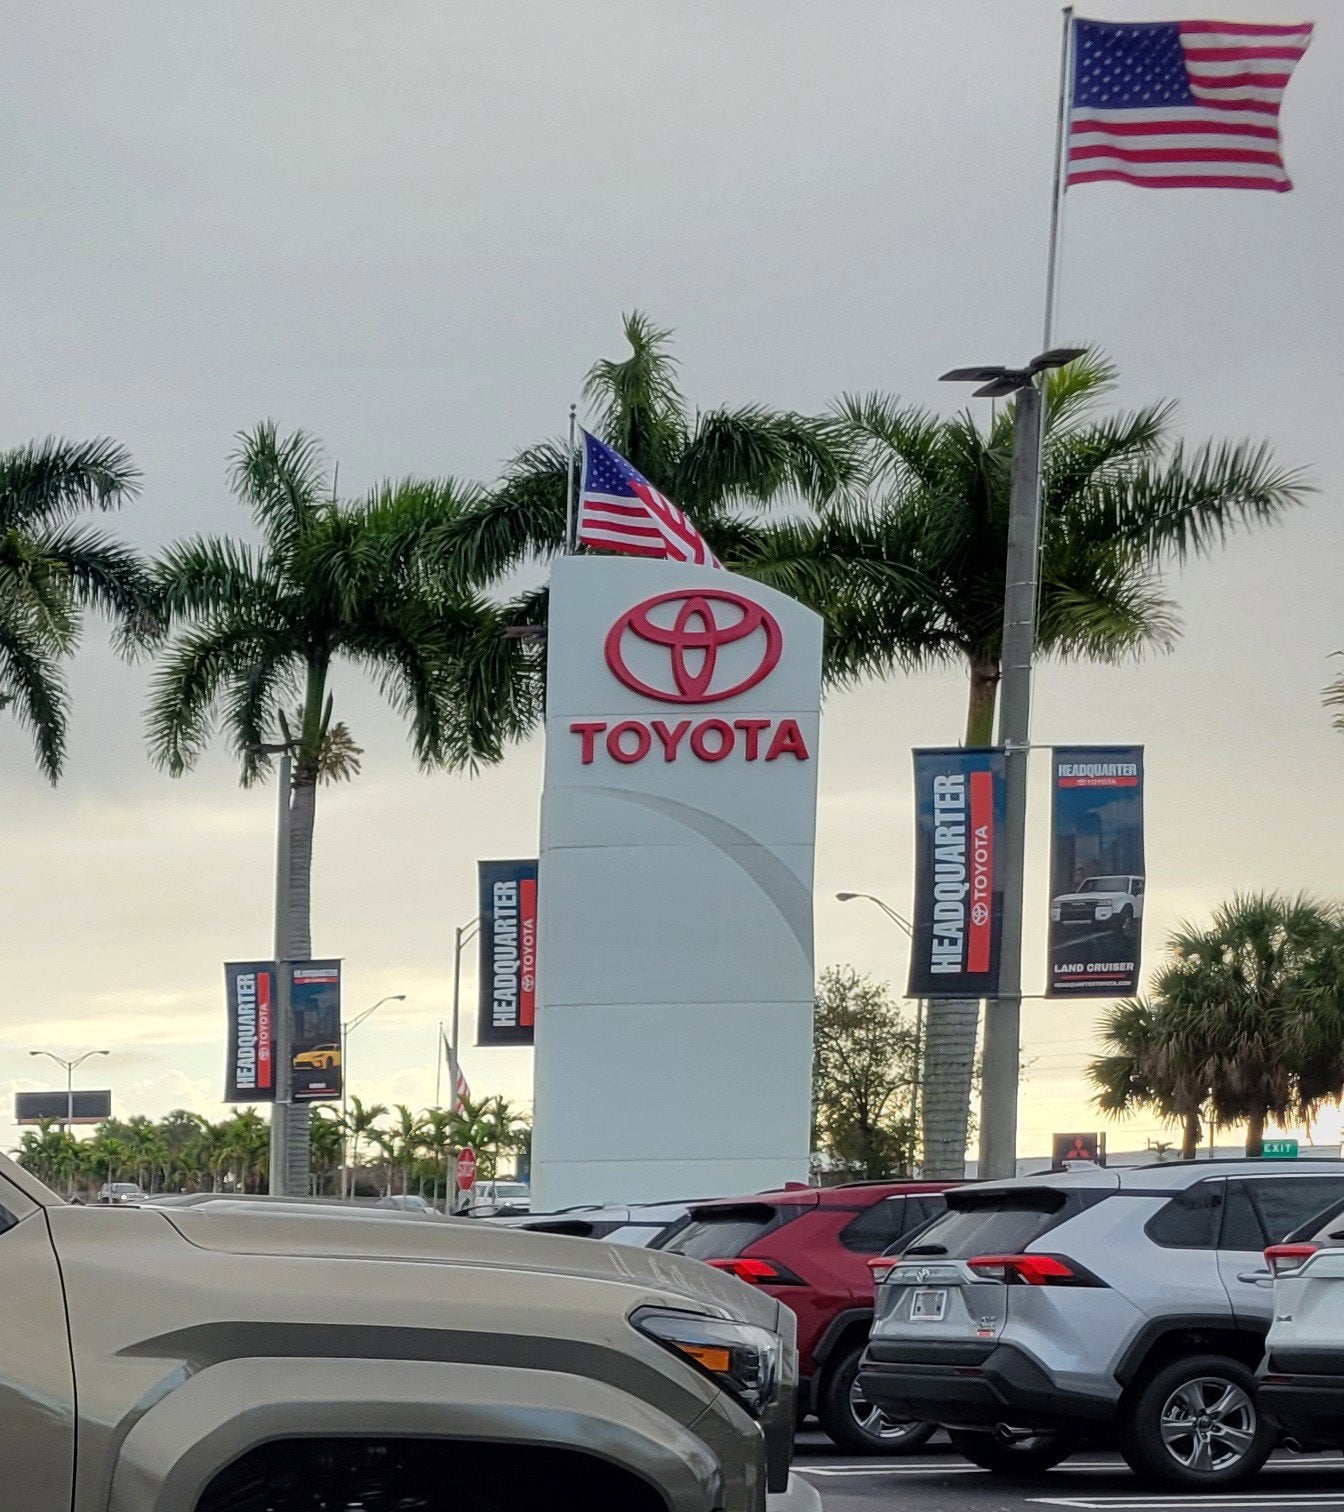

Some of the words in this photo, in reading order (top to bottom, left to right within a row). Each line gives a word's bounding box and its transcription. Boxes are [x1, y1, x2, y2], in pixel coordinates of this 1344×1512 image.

[569, 718, 810, 764] TOYOTA
[1058, 763, 1137, 778] HEADQUARTER
[930, 774, 970, 973] HEADQUARTER
[974, 825, 989, 900] TOYOTA
[493, 881, 520, 1027] HEADQUARTER
[523, 917, 534, 973] TOYOTA
[1054, 963, 1084, 973] LAND
[1086, 962, 1134, 972] CRUISER
[236, 973, 257, 1089] HEADQUARTER
[1263, 1143, 1291, 1153] EXIT
